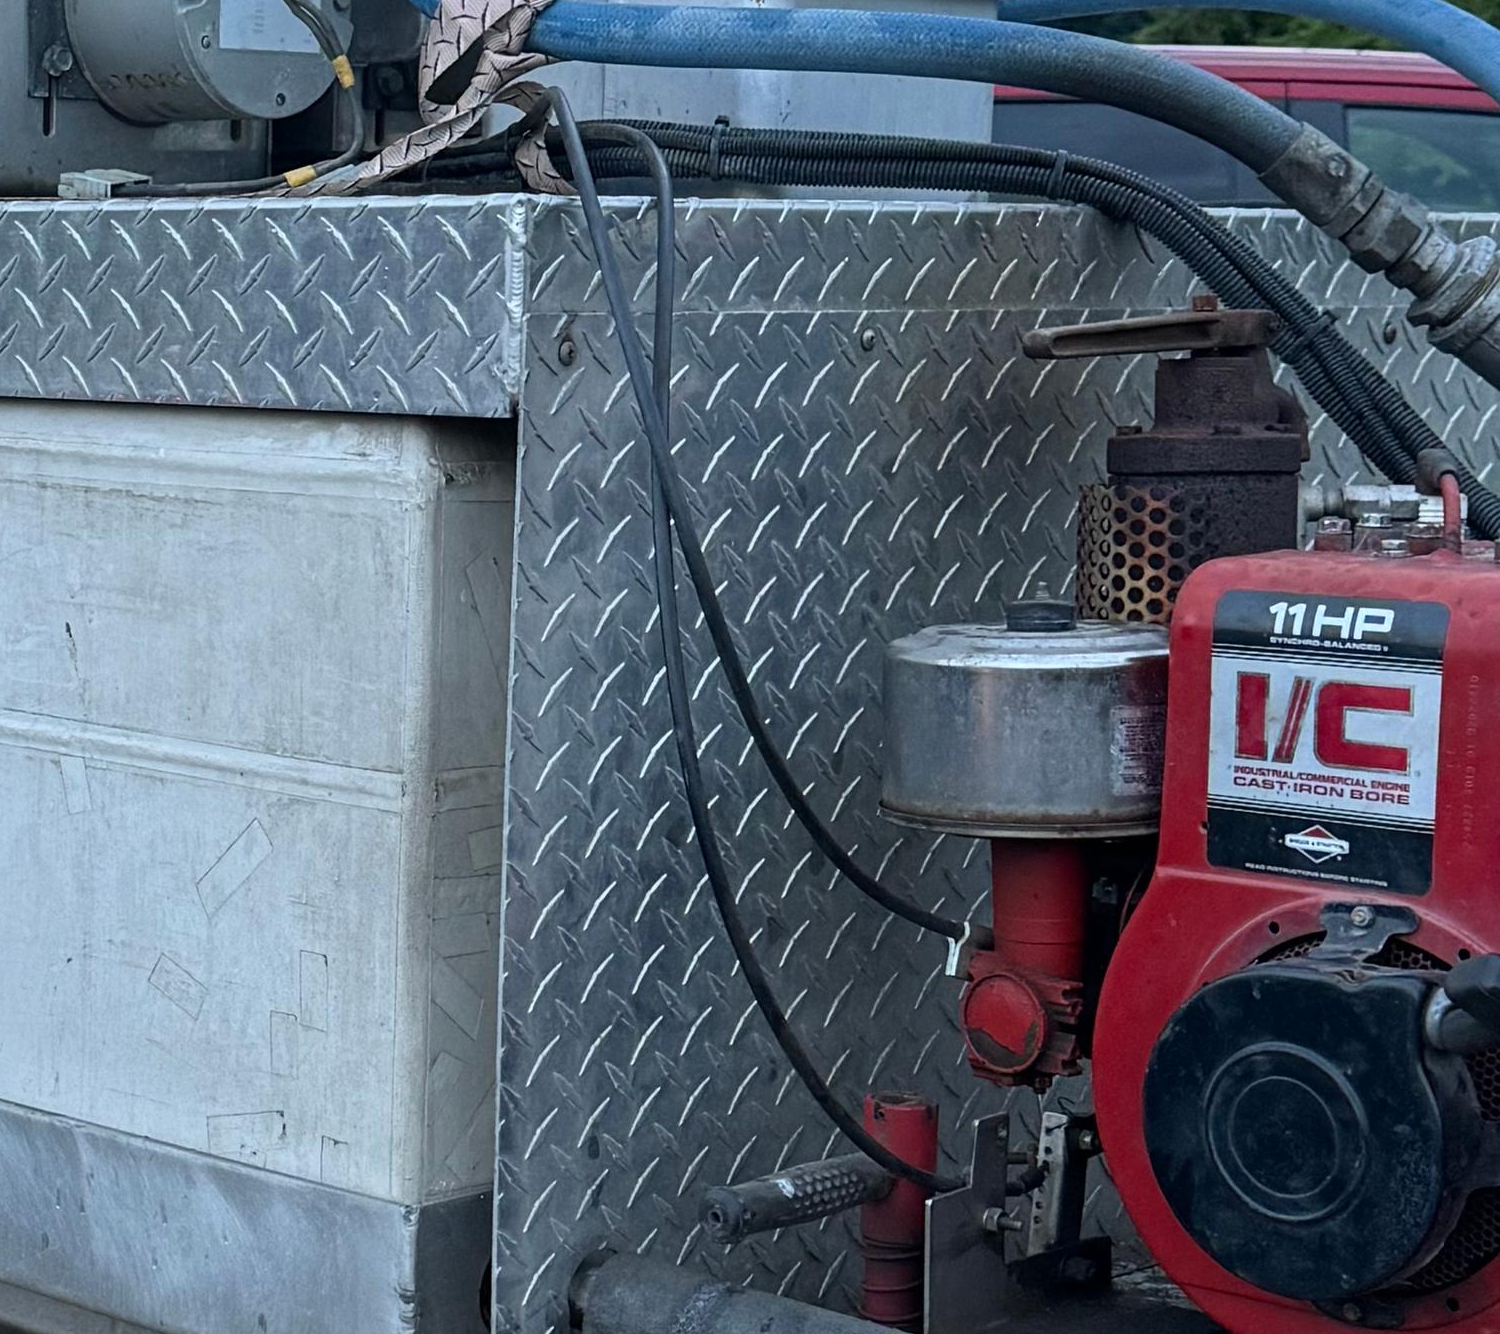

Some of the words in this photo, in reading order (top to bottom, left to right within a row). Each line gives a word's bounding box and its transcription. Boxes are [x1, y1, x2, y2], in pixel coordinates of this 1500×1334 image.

[1234, 671, 1415, 777] I/C
[1234, 765, 1368, 788] INDUSTRIAL/COMMERCIAL
[1370, 781, 1411, 793] ENGINE
[1350, 789, 1410, 805] BORE
